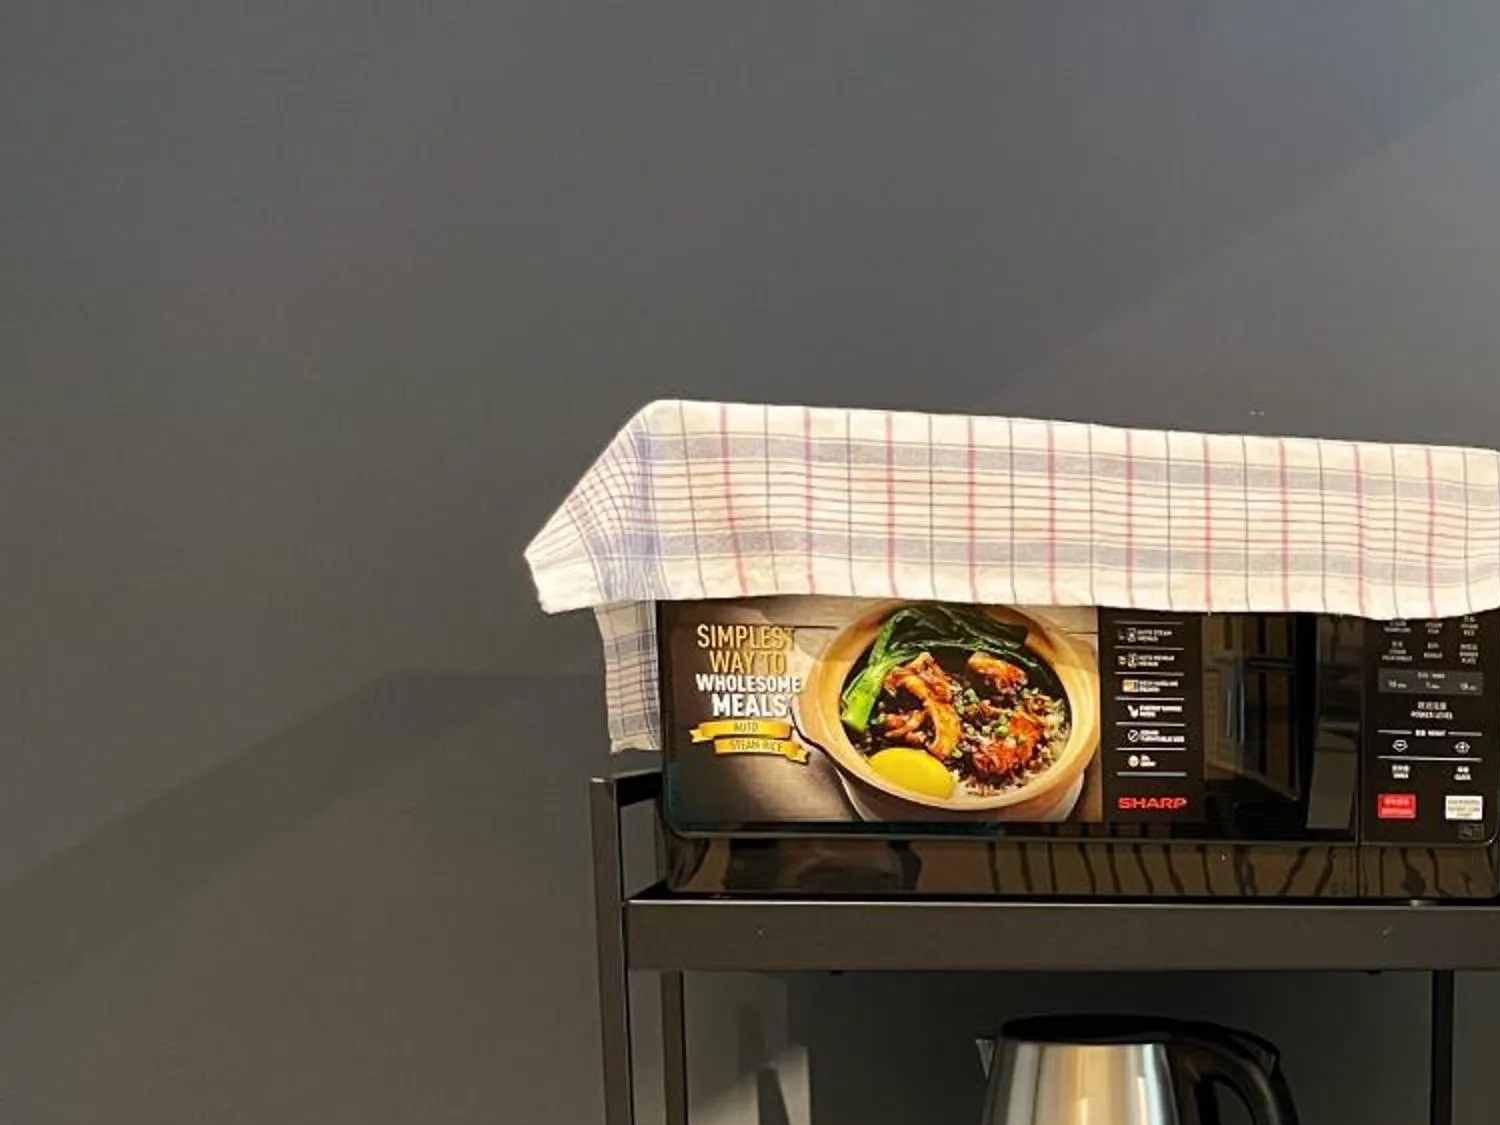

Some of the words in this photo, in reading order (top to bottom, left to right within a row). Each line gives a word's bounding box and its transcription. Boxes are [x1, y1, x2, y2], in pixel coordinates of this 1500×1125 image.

[697, 624, 795, 649] SIMPLEST
[709, 650, 754, 673] WAY
[760, 651, 786, 674] TO
[695, 673, 802, 692] WHOLESOME
[711, 693, 788, 717] MEALS
[1118, 797, 1188, 809] SHARP
